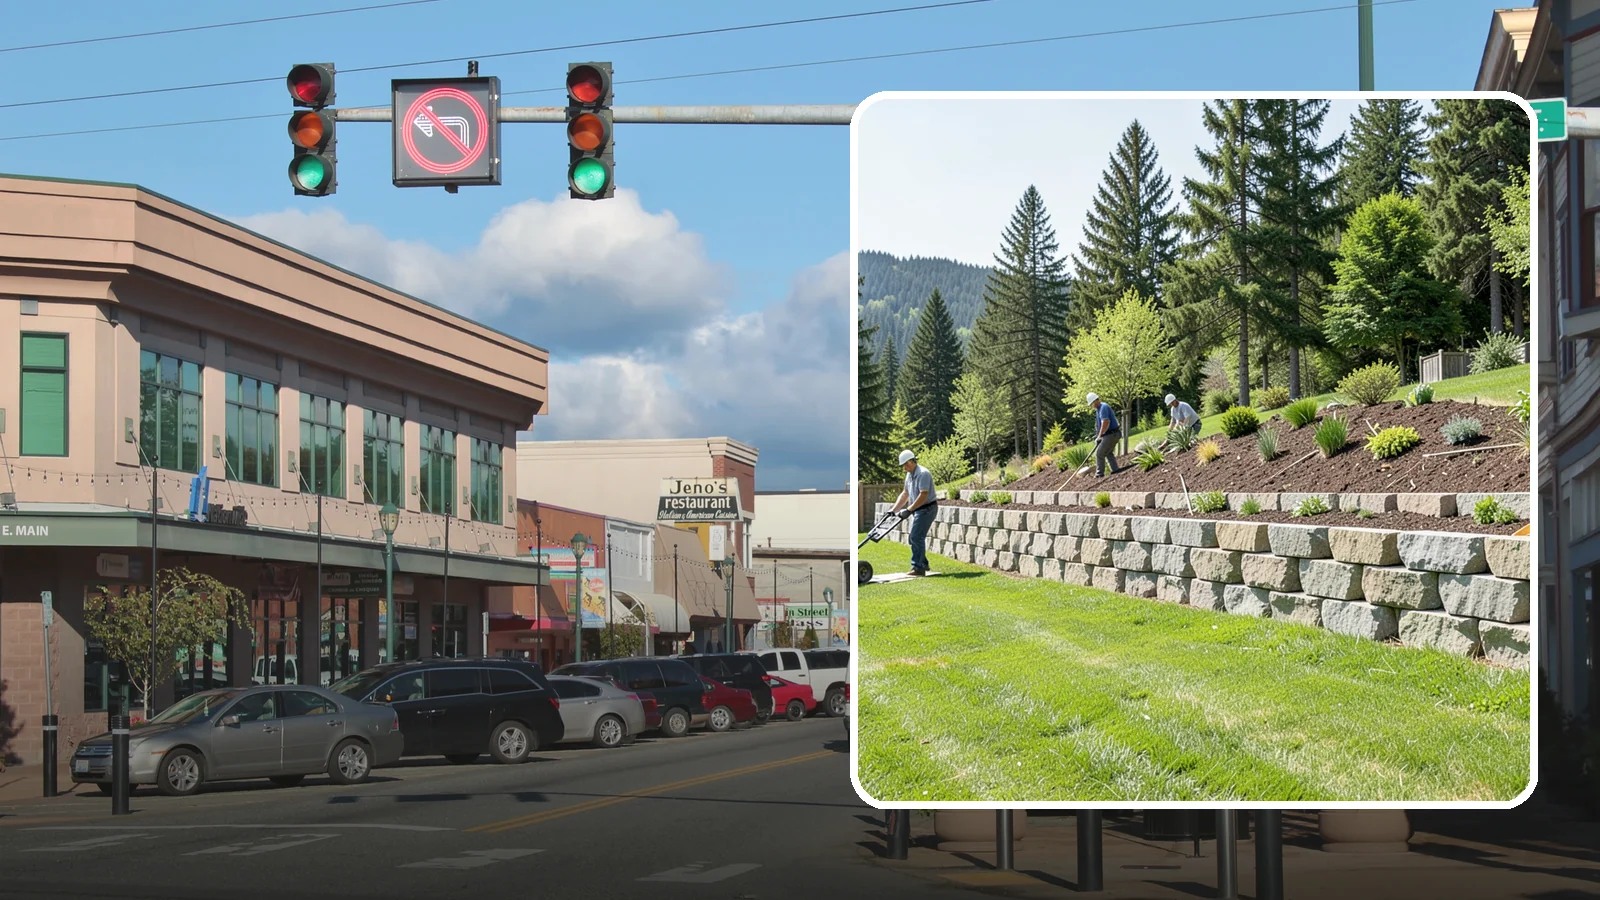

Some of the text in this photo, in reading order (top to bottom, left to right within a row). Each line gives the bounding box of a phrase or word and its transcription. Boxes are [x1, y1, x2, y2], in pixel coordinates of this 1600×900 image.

[670, 480, 727, 494] Jeno's
[665, 496, 731, 509] restaurant
[658, 510, 681, 519] Italian
[686, 509, 714, 519] American
[715, 509, 737, 519] Cuisine
[2, 525, 49, 536] E. MAIN
[786, 608, 795, 617] in
[797, 607, 828, 617] Street
[791, 619, 823, 627] lass
